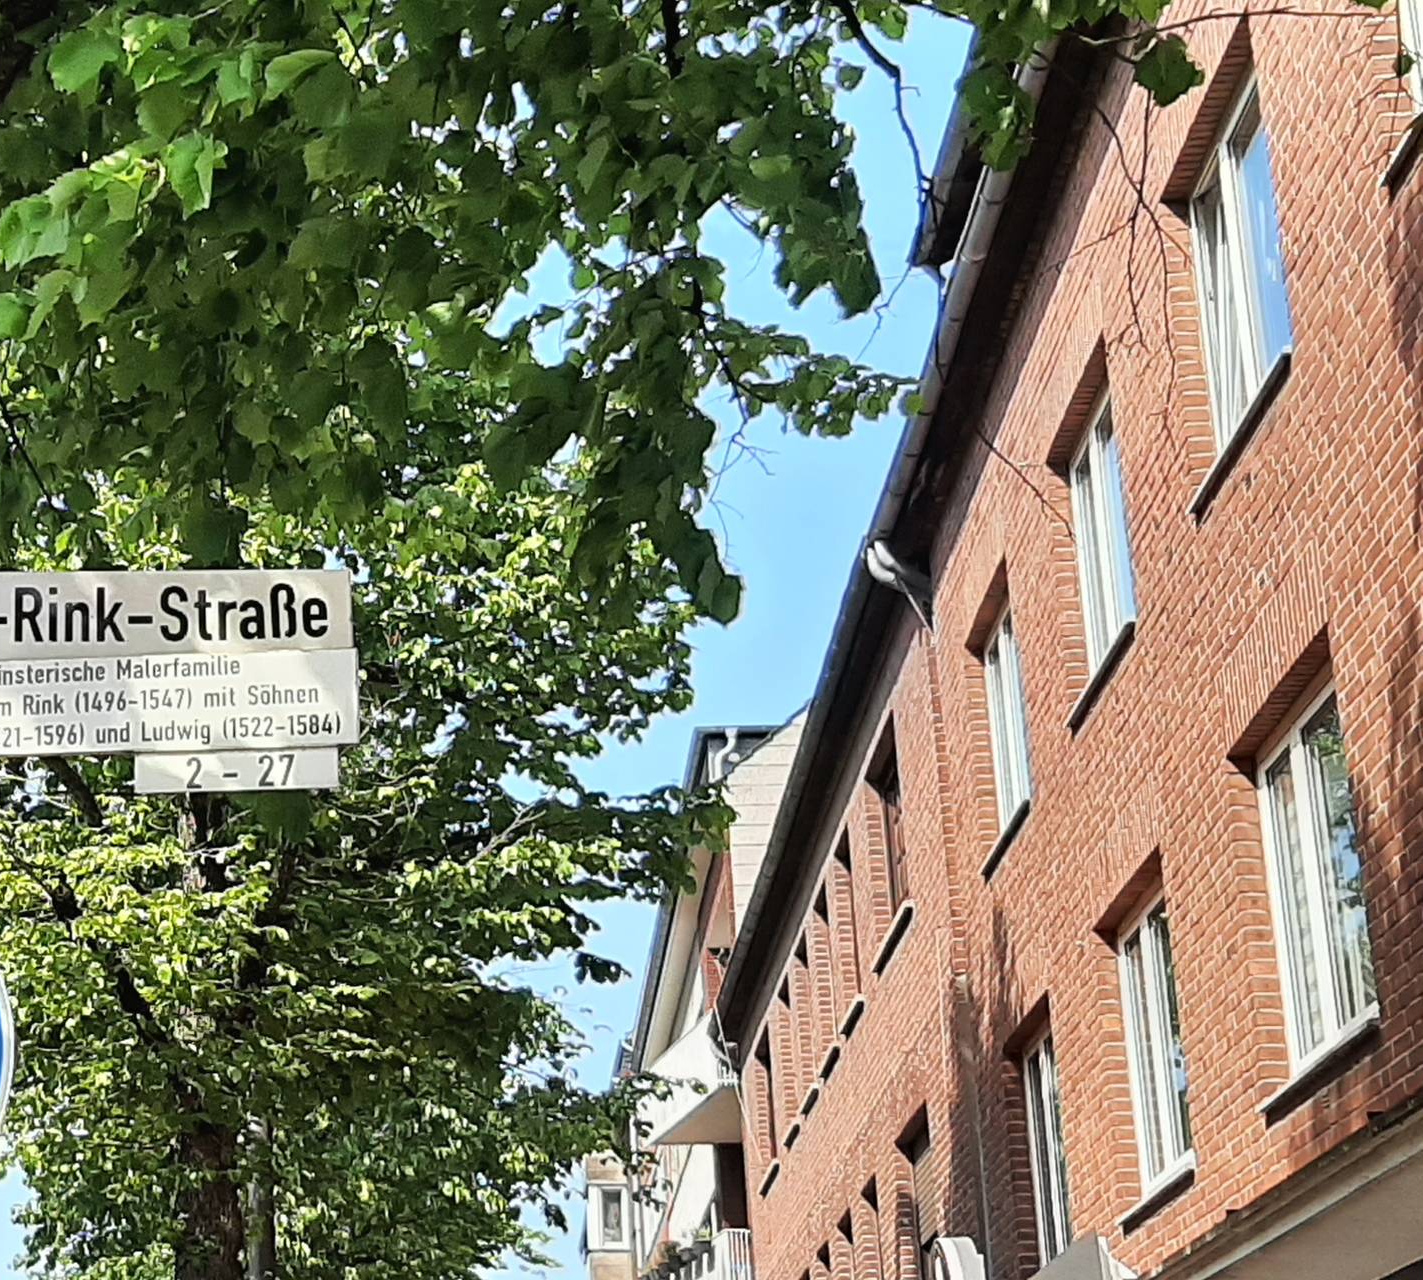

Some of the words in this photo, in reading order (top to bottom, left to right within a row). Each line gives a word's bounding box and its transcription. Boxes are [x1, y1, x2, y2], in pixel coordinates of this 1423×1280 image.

[117, 655, 241, 680] Malerfamilie
[23, 693, 64, 716] Rink
[76, 688, 192, 714] (1496-1547)
[204, 686, 236, 708] mit
[248, 683, 319, 706] Söhnen
[96, 722, 130, 744] und
[141, 719, 211, 744] Ludwig
[223, 711, 341, 739] (1522-1584)
[186, 756, 202, 789] 2
[258, 753, 295, 787] 27
